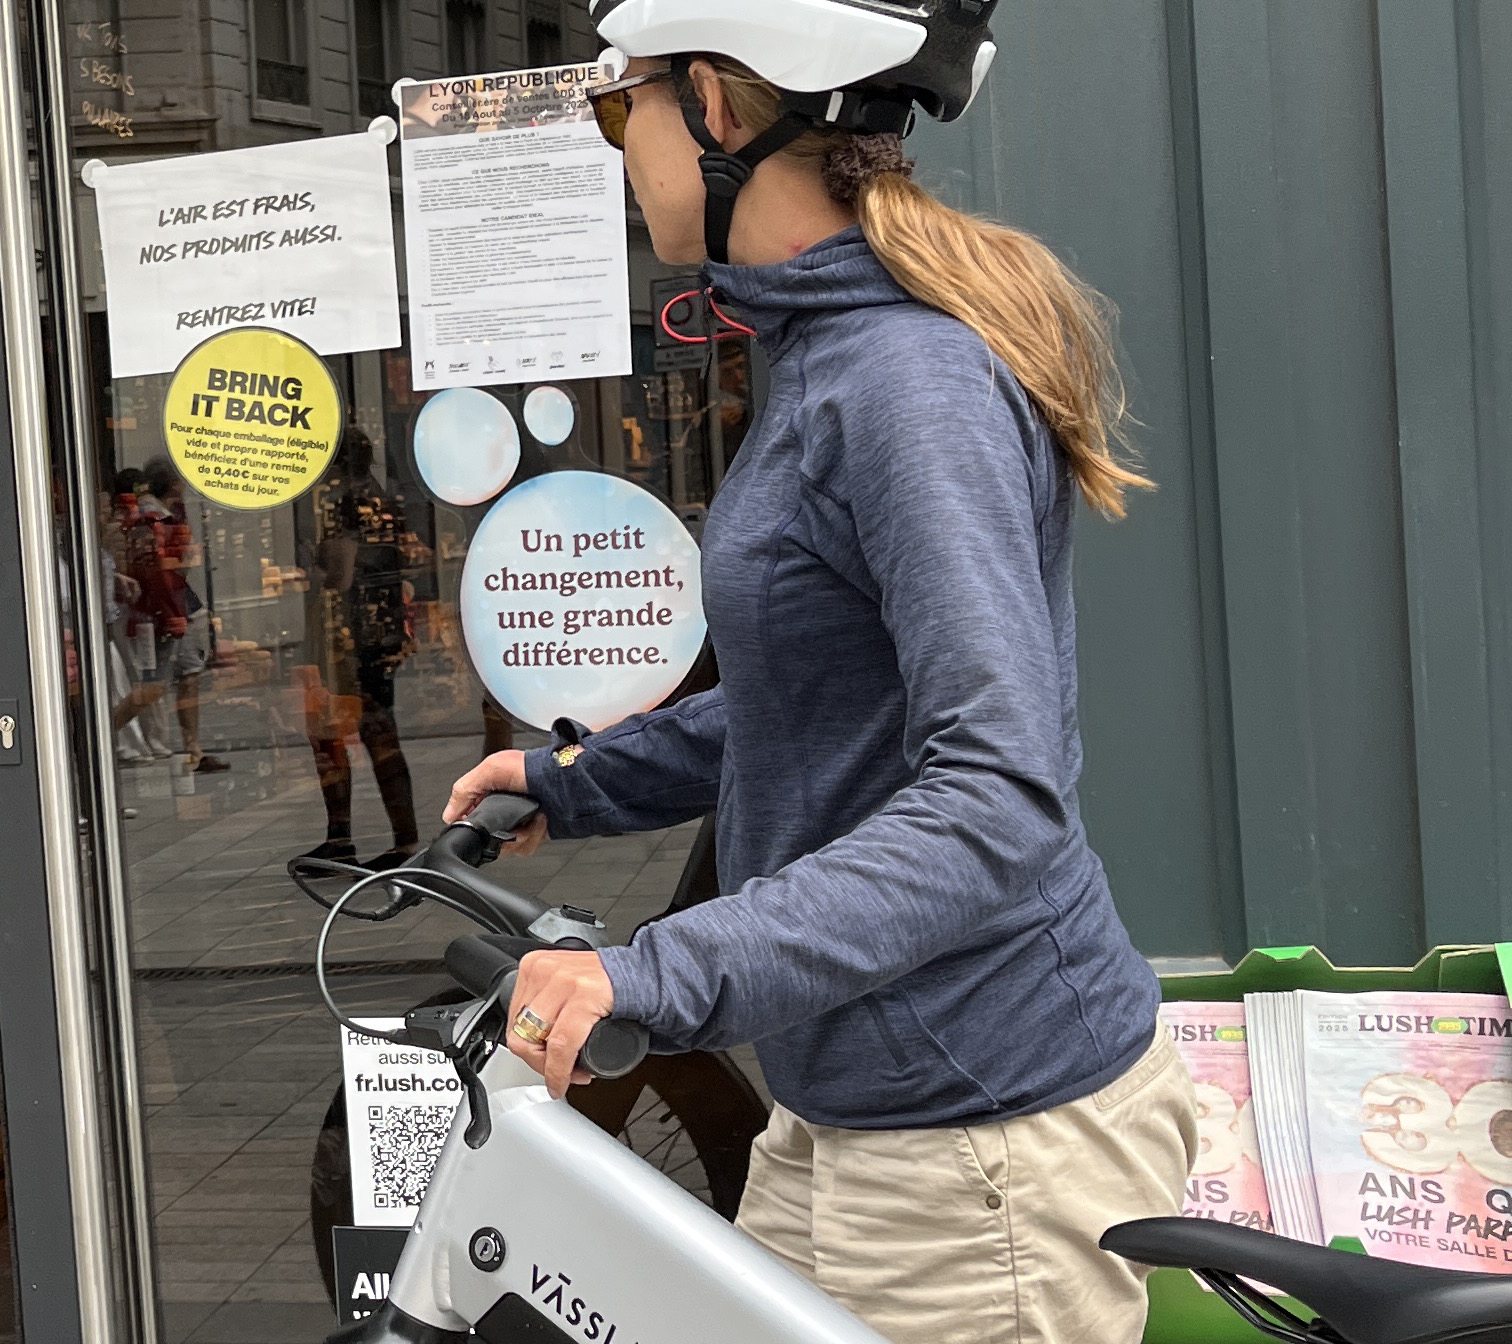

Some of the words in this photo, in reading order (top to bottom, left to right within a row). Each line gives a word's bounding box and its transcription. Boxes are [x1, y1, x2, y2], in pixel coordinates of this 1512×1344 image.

[429, 80, 477, 98] LYON
[482, 66, 600, 92] REPUBLIQUE
[158, 205, 209, 228] L'AIR
[212, 198, 250, 221] EST
[253, 191, 316, 216] FRAIS,
[139, 243, 178, 265] NOS
[181, 230, 277, 260] PRODUITS
[279, 224, 344, 248] AUSSI.
[176, 302, 266, 330] RENTREZ
[270, 297, 317, 320] VITE!
[207, 368, 304, 402] BRING
[190, 393, 221, 418] IT
[224, 397, 314, 430] BACK
[170, 422, 194, 434] Pour
[195, 426, 231, 439] chaque
[233, 431, 285, 447] emballage
[186, 438, 208, 449] vide
[210, 441, 221, 450] et
[222, 444, 258, 457] propre
[260, 447, 309, 463] rapporté,
[184, 450, 238, 465] bénéficiez
[240, 457, 269, 469] d'une
[271, 463, 307, 474] remise
[198, 464, 211, 475] de
[252, 472, 269, 482] sur
[271, 475, 290, 485] vos
[204, 478, 239, 491] achats
[241, 482, 256, 492] du
[256, 485, 280, 496] jour.
[521, 528, 563, 553] Un
[572, 524, 646, 558] petit
[484, 565, 684, 597] changement,
[497, 610, 554, 629] une
[562, 601, 674, 635] grande
[502, 640, 669, 667] différence.
[1358, 1014, 1435, 1034] LUSH
[378, 1049, 423, 1065] aussi
[355, 1073, 465, 1092] fr.lush.co
[1358, 1172, 1445, 1204] ANS
[1360, 1201, 1435, 1230] LUSH
[1364, 1227, 1431, 1249] VOTRE
[1436, 1238, 1497, 1259] SALLE
